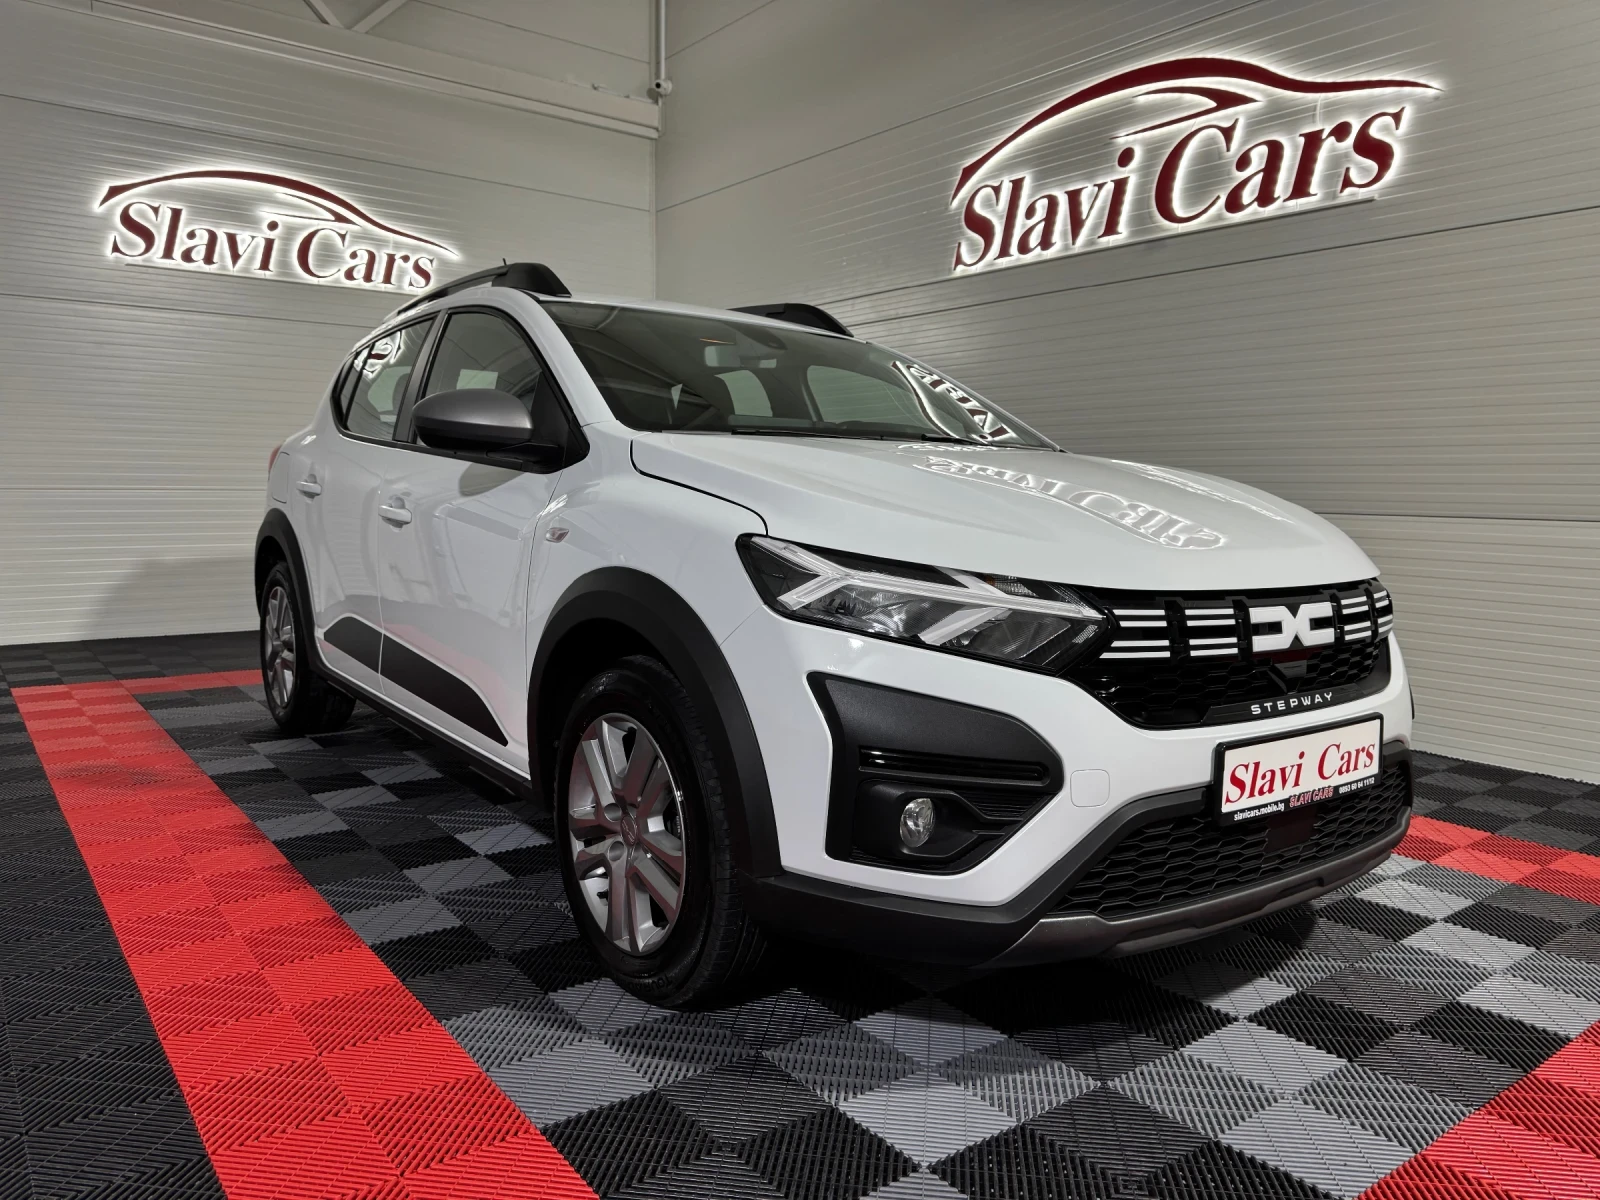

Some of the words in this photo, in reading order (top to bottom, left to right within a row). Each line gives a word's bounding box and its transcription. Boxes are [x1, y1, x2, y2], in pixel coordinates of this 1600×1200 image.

[953, 147, 1135, 271] Slavi
[1154, 106, 1406, 224] Cars
[111, 201, 279, 273] Slavi
[297, 228, 435, 289] Cars
[1251, 691, 1334, 715] STEPWAY
[1224, 751, 1306, 805] Slavi
[1317, 742, 1376, 781] Cars
[1233, 802, 1285, 821] slavicars.mobile.bg
[1289, 790, 1312, 808] SLAVI
[1312, 786, 1334, 802] CARS
